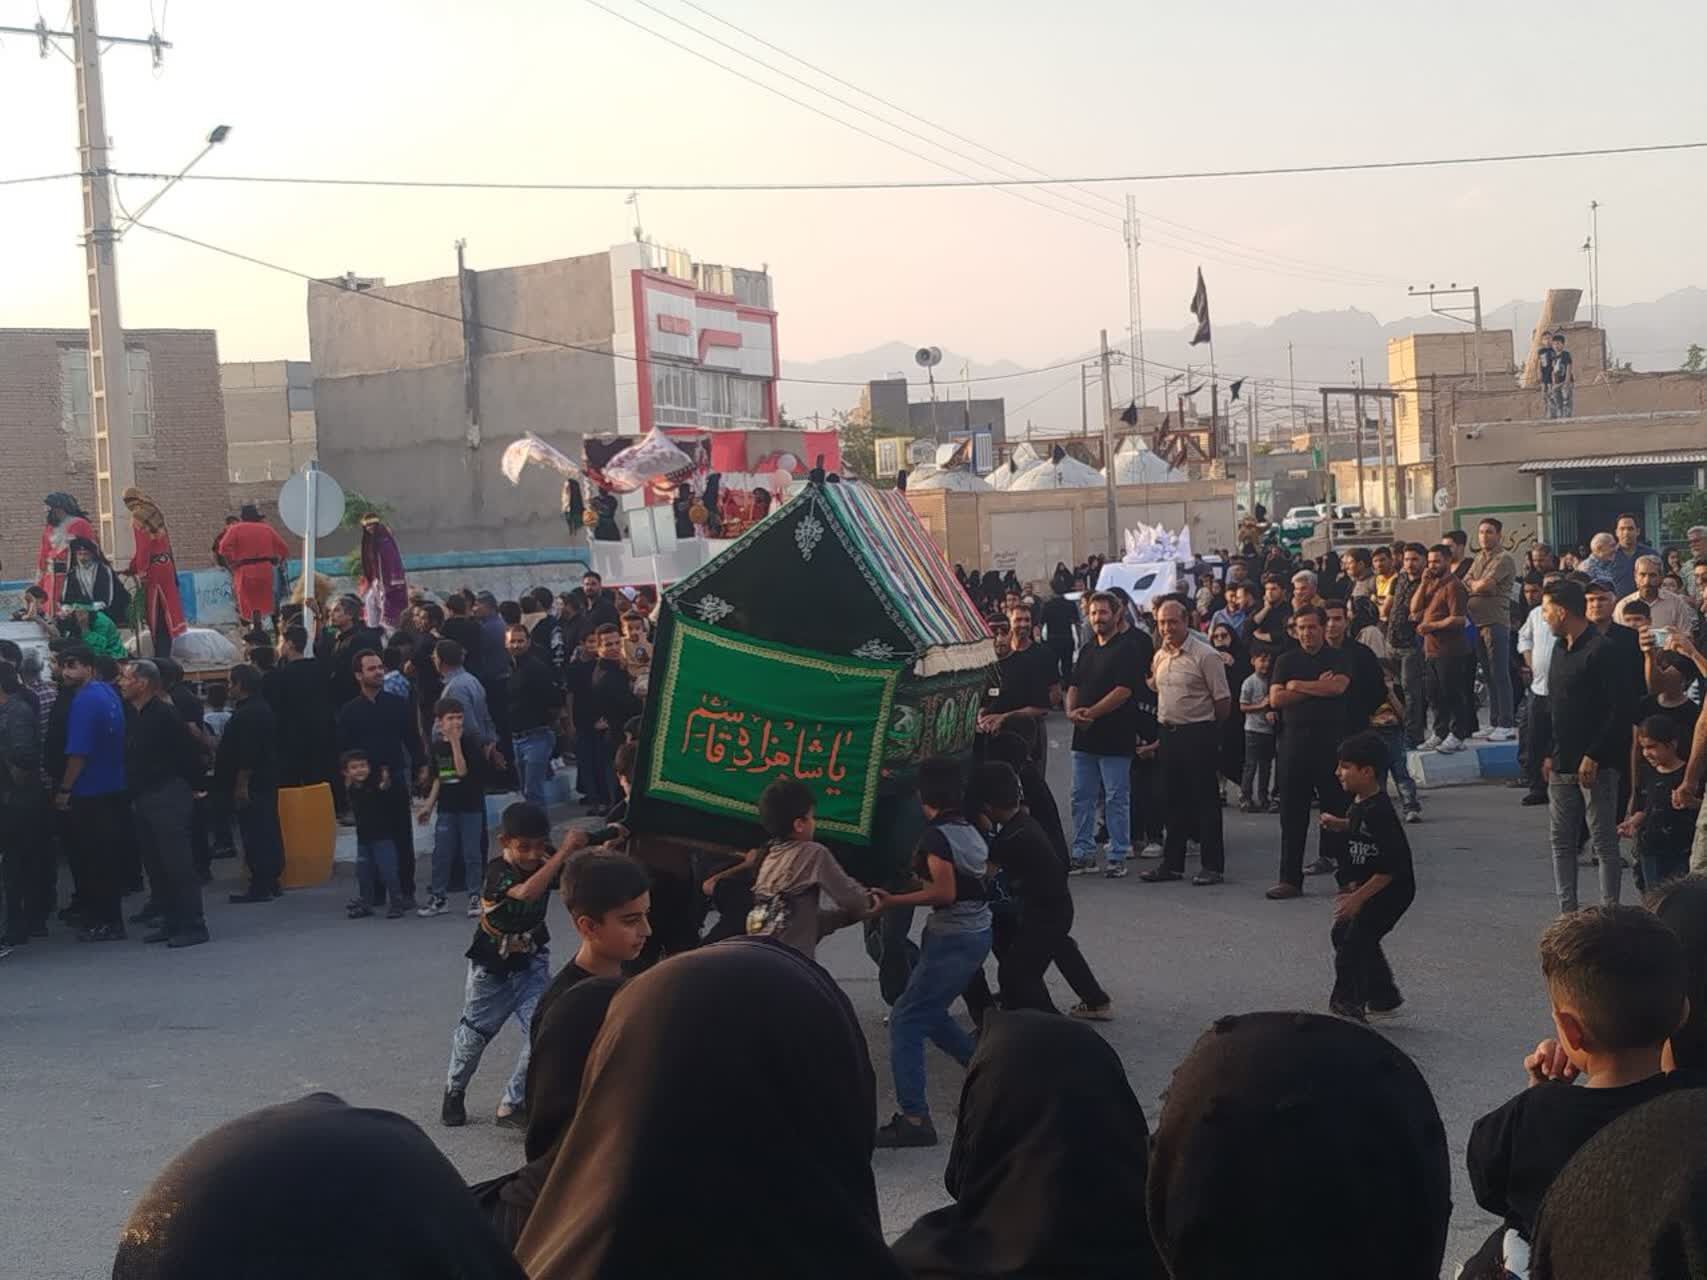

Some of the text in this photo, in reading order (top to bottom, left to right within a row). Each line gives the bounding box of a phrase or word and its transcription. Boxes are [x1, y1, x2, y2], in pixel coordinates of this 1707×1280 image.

[681, 697, 745, 764] قاسم
[733, 716, 823, 780] شاهزاده
[826, 730, 852, 795] یا
